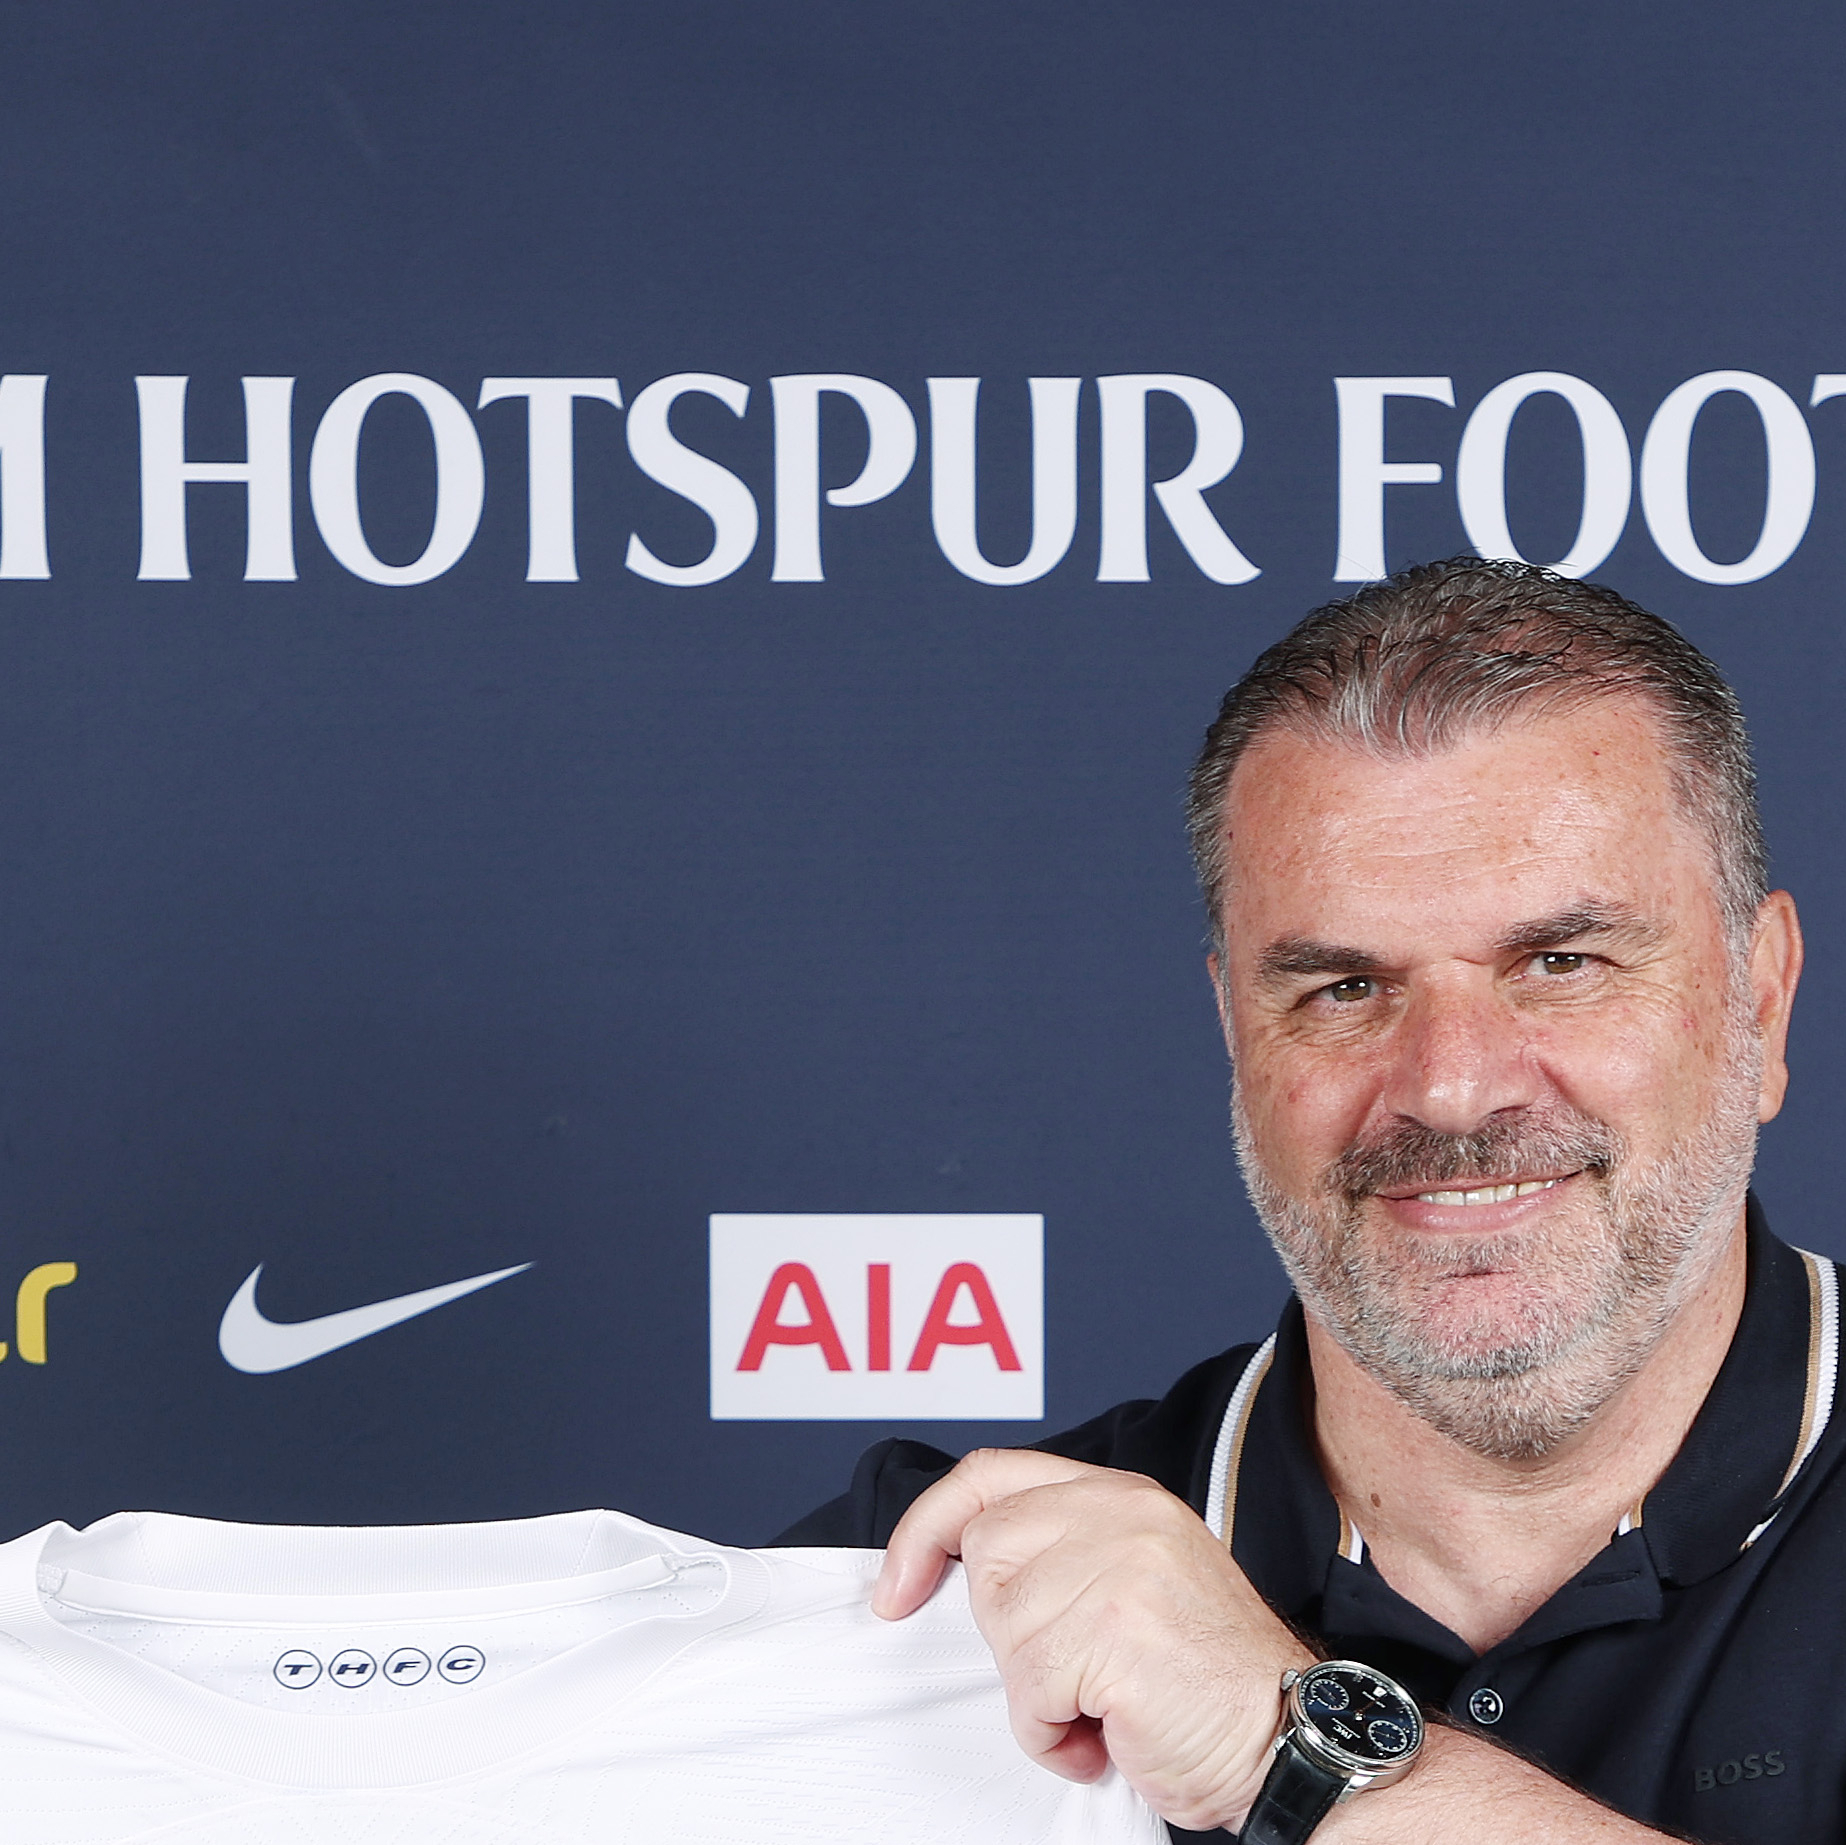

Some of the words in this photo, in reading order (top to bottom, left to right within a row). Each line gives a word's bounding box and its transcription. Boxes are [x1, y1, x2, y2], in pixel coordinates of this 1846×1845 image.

[133, 372, 1263, 588] HOTSPUR
[737, 1262, 1022, 1372] AIA
[1694, 1750, 1786, 1793] BOSS
